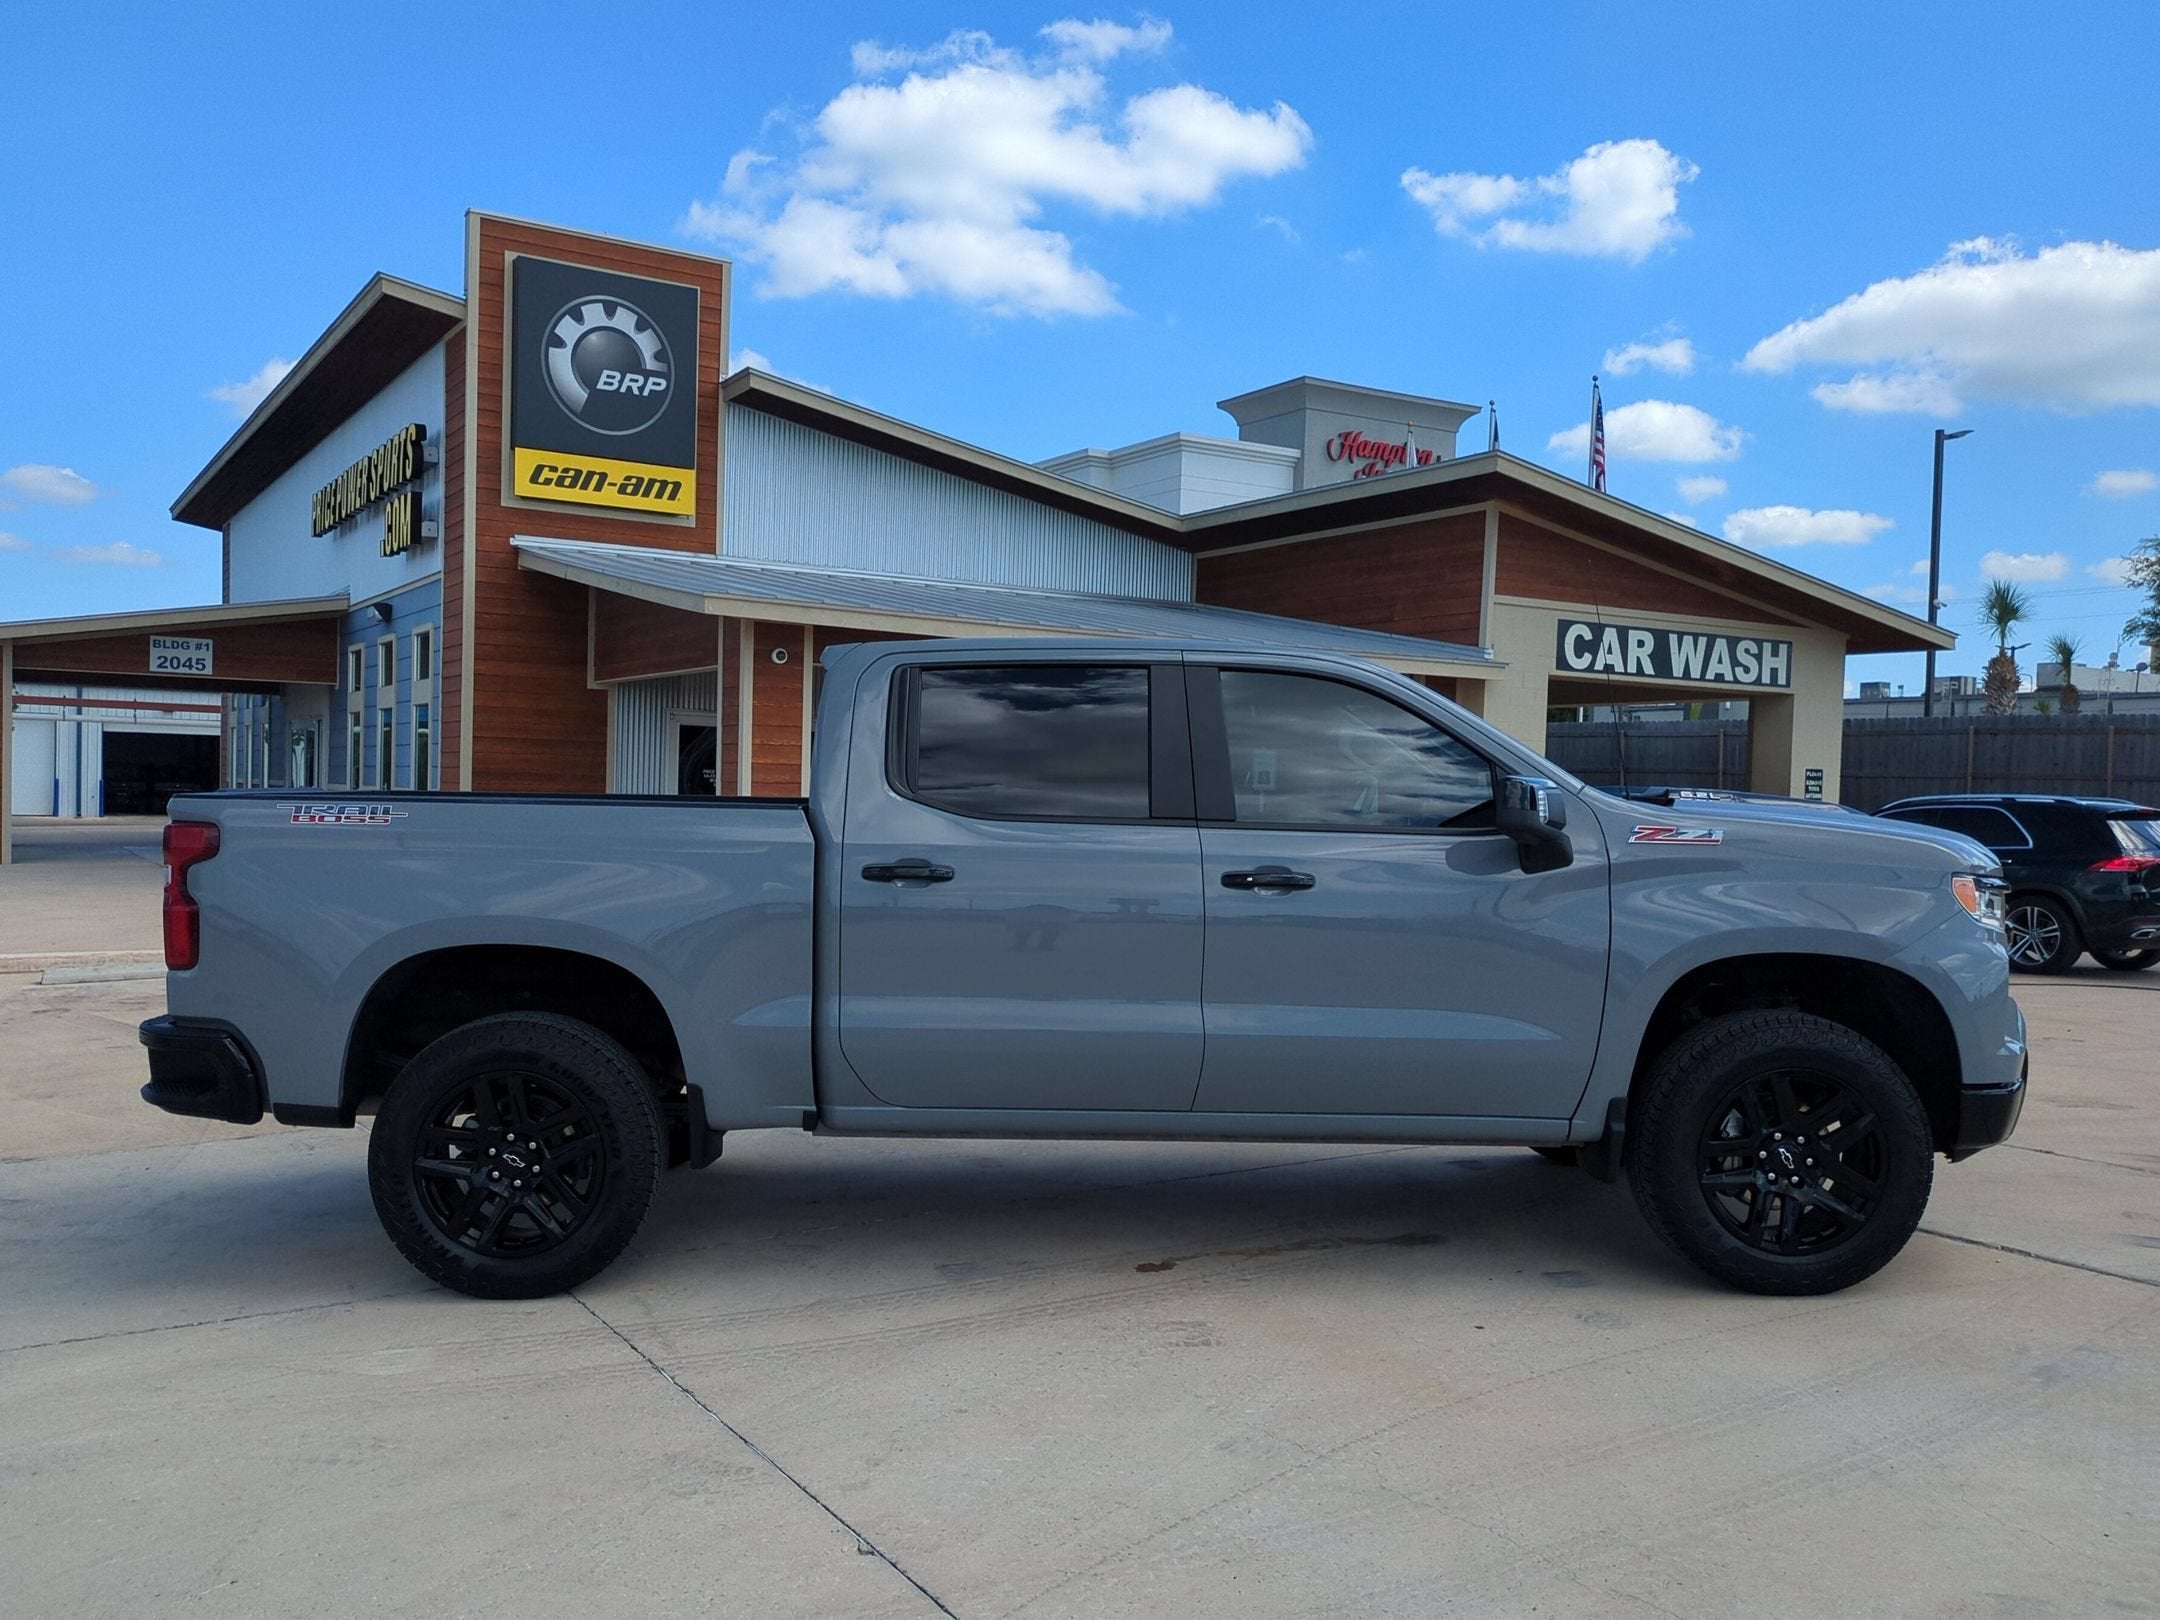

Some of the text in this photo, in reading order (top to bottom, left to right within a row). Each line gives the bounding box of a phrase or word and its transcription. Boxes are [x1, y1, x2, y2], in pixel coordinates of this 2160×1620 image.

[596, 369, 668, 397] BRP
[528, 463, 683, 502] can-am
[312, 479, 337, 537] PRICE
[380, 491, 418, 557] .COM
[153, 639, 210, 652] BLDG #1
[1564, 623, 1788, 685] CAR WASH
[156, 655, 207, 672] 2045
[277, 804, 408, 817] TRAIL
[291, 814, 391, 824] BOSS
[1628, 825, 1724, 844] Z71
